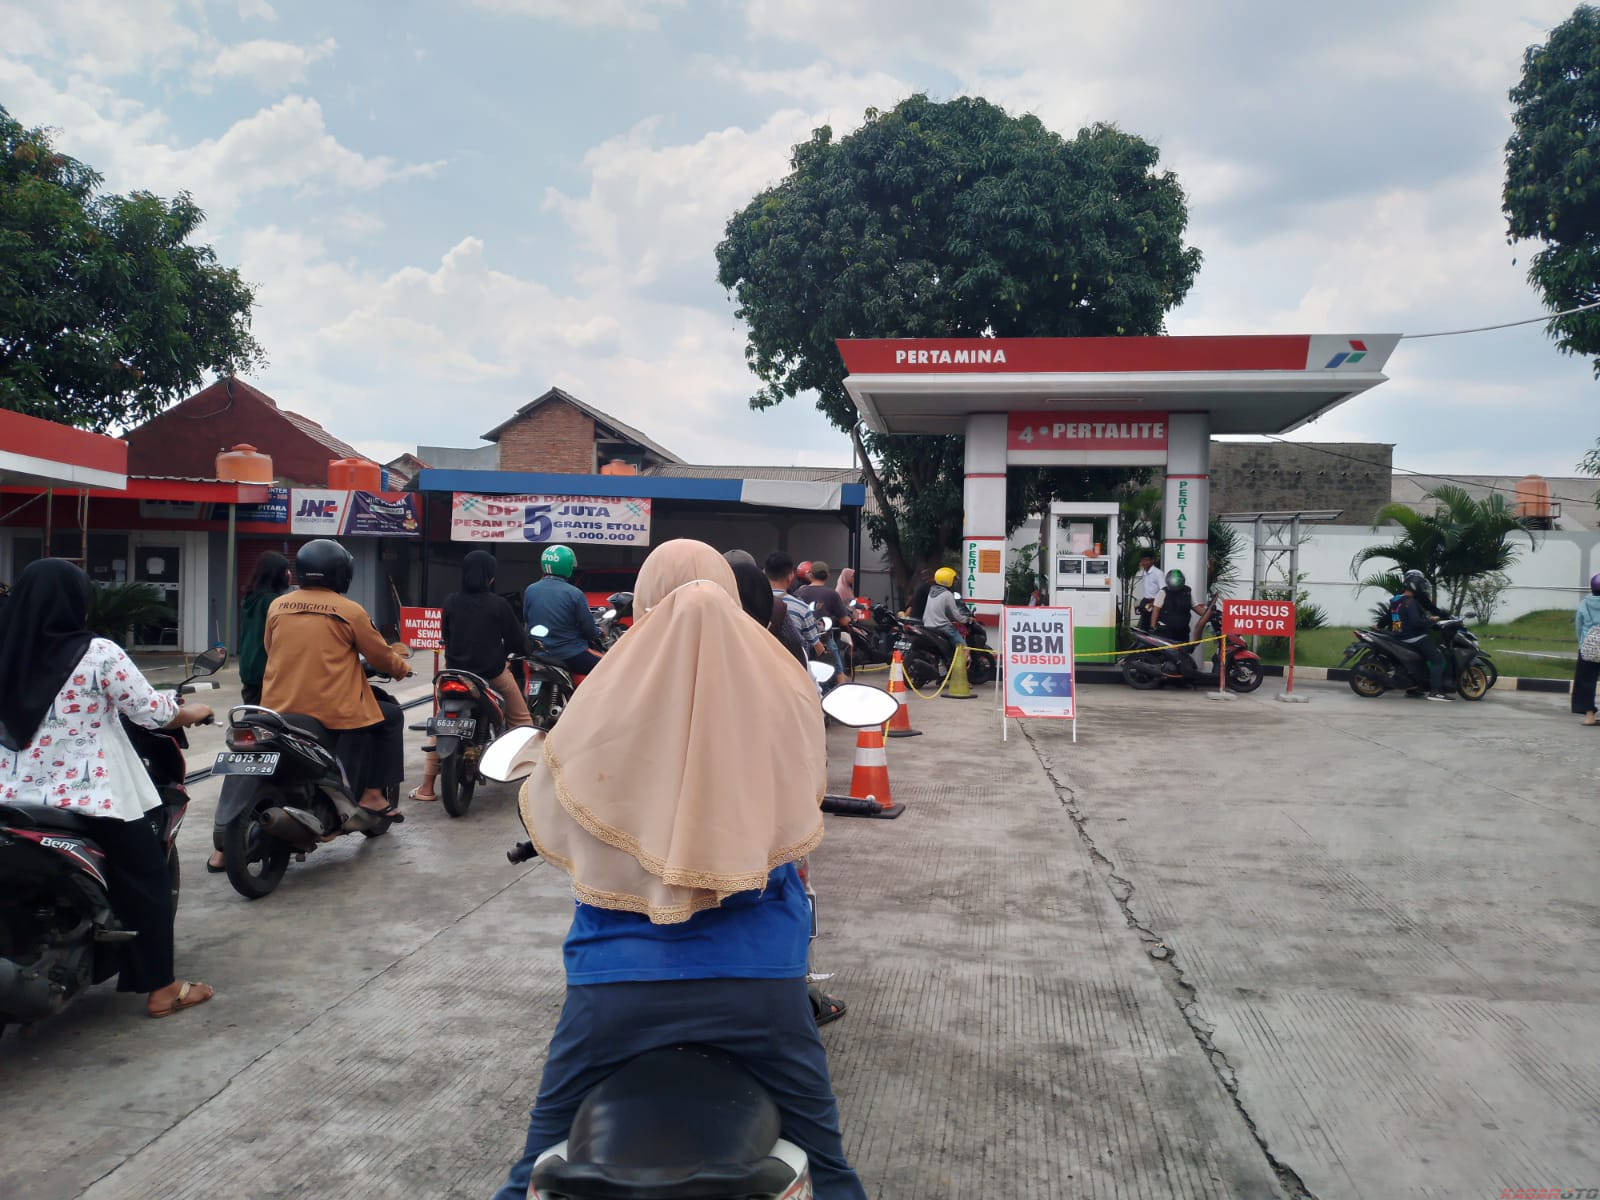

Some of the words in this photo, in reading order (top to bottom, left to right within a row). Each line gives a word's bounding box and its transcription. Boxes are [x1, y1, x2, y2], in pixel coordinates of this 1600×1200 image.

[896, 349, 1007, 364] PERTAMINA
[1018, 426, 1034, 443] 4
[1052, 422, 1164, 439] PERTALITE
[482, 495, 539, 503] PROMO
[296, 499, 338, 517] JNE
[454, 518, 502, 527] PESAN
[488, 504, 519, 516] DP
[523, 505, 553, 542] 5
[558, 505, 610, 517] JUTA
[1177, 481, 1188, 559] PERTALITE
[553, 521, 602, 530] GRATIS
[606, 522, 647, 531] ETOLL
[471, 530, 504, 538] POM
[566, 531, 635, 541] 1.000.000
[968, 542, 976, 612] PERTALIT
[278, 602, 337, 612] PRODIGIOUS
[1229, 604, 1289, 617] KHUSUS
[425, 609, 442, 619] MAA
[405, 619, 441, 629] MATIKAN
[1012, 621, 1064, 633] JALUR
[1234, 618, 1285, 630] MOTOR
[410, 638, 442, 648] MENGIS
[1011, 635, 1064, 654] BBM
[1011, 654, 1066, 665] SUBSIDI
